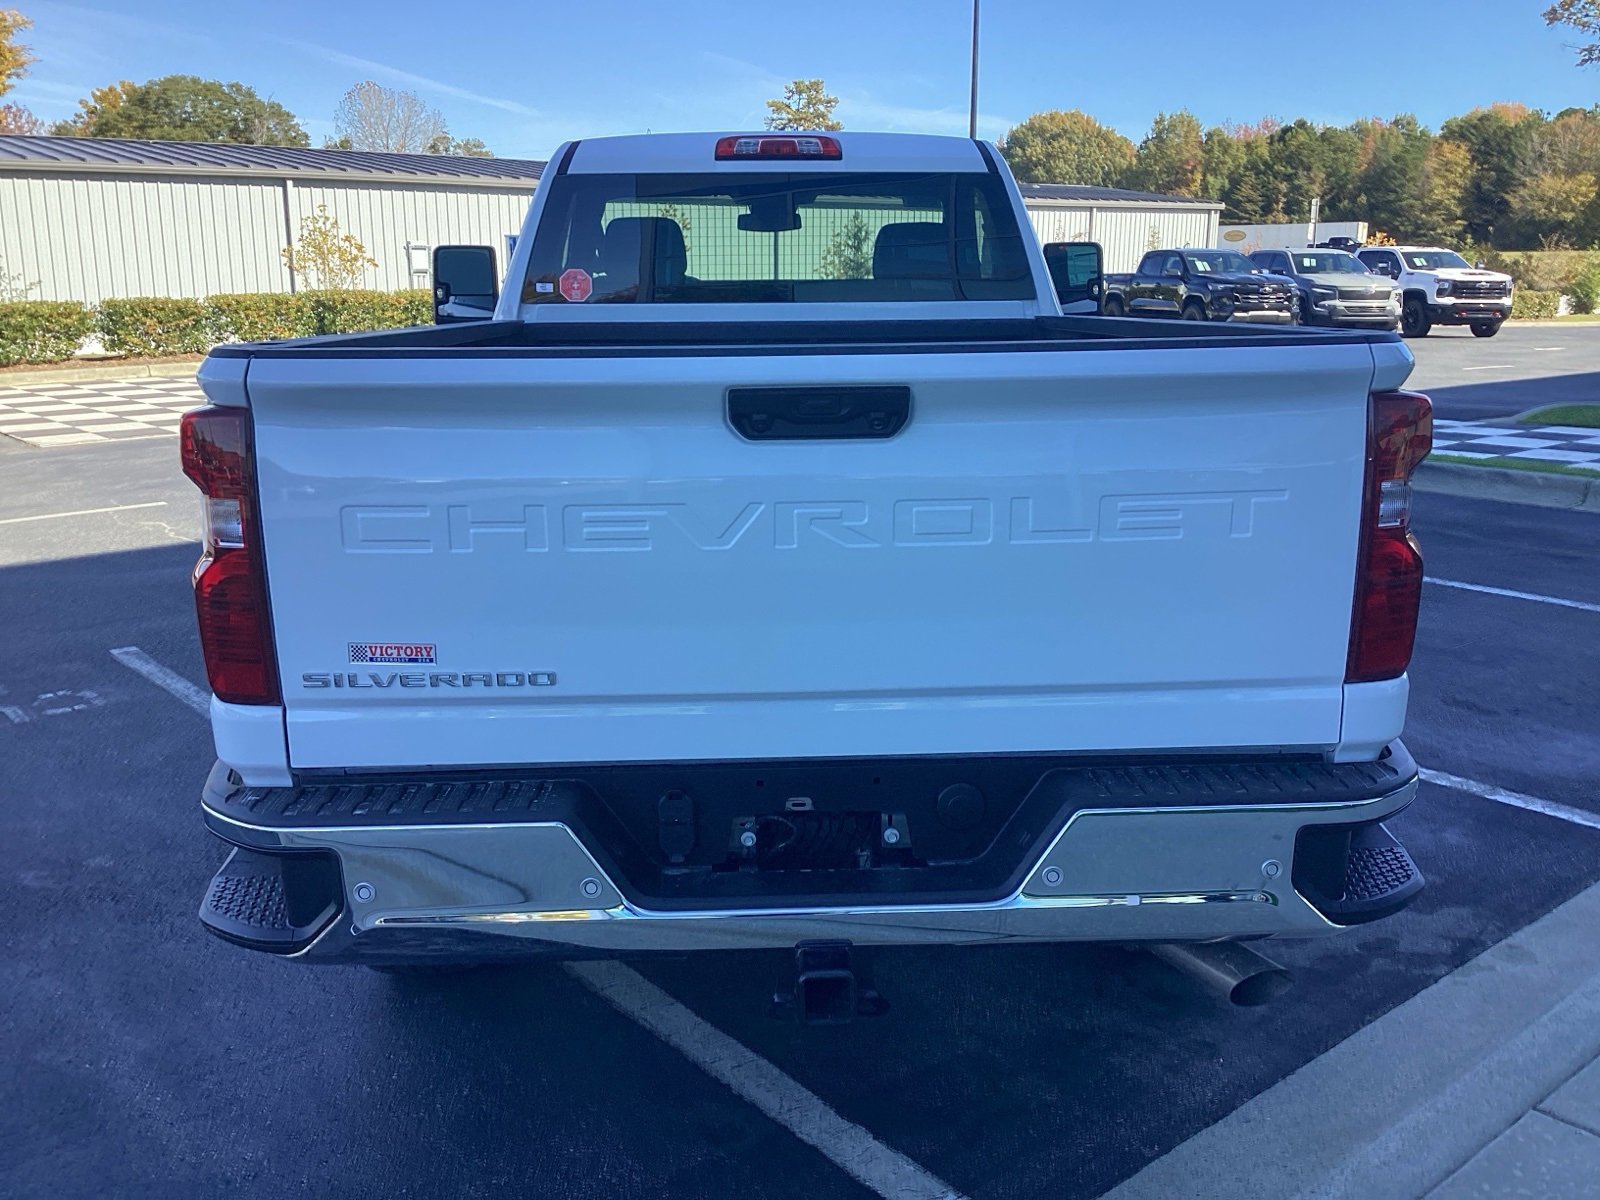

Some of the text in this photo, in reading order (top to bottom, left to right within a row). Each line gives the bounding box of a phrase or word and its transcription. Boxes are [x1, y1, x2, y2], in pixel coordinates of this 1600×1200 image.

[339, 489, 1289, 554] CHEVROLET
[368, 645, 433, 657] VICTORY
[302, 671, 557, 688] SILVERADO
